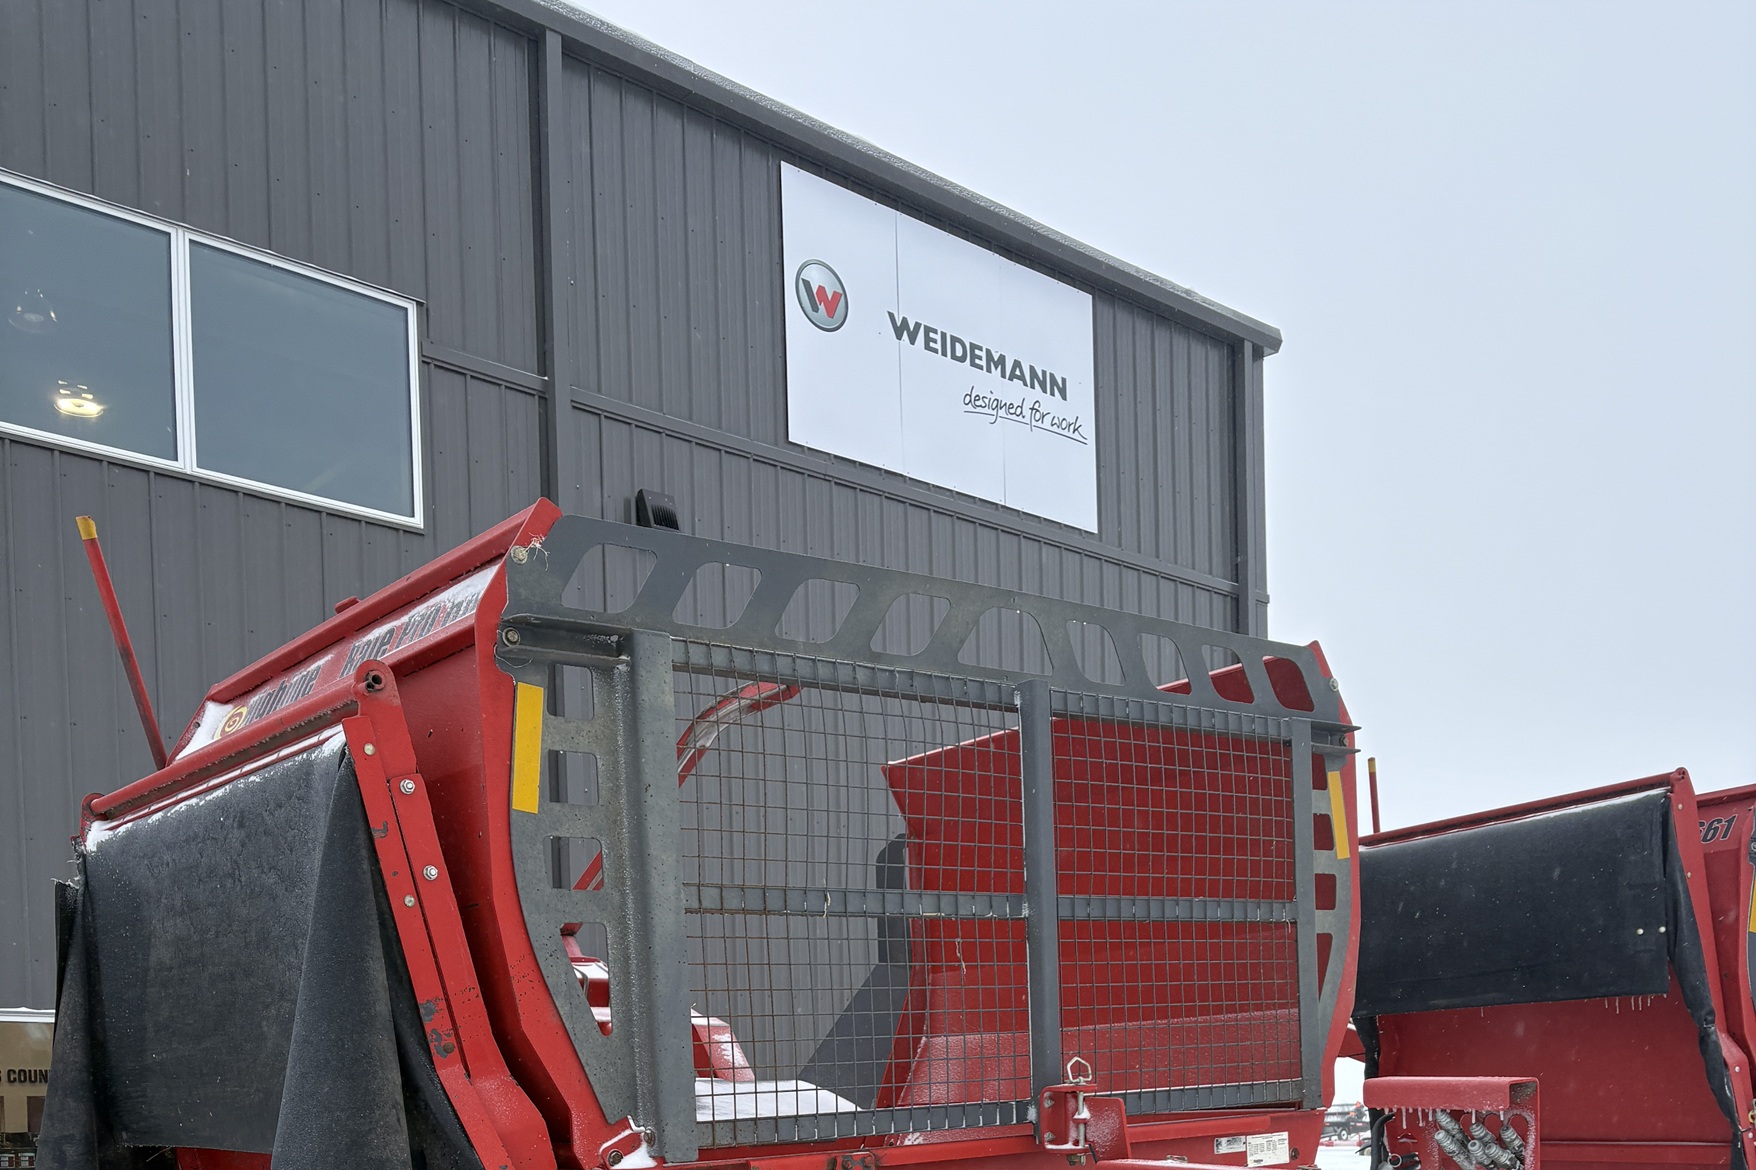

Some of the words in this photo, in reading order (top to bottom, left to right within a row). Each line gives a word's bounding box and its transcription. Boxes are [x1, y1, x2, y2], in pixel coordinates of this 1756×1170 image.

[887, 310, 1067, 401] WEIDEMANN
[963, 386, 1025, 424] designed
[1029, 400, 1050, 432] for
[1051, 416, 1088, 440] work
[7, 1069, 51, 1083] COUN
